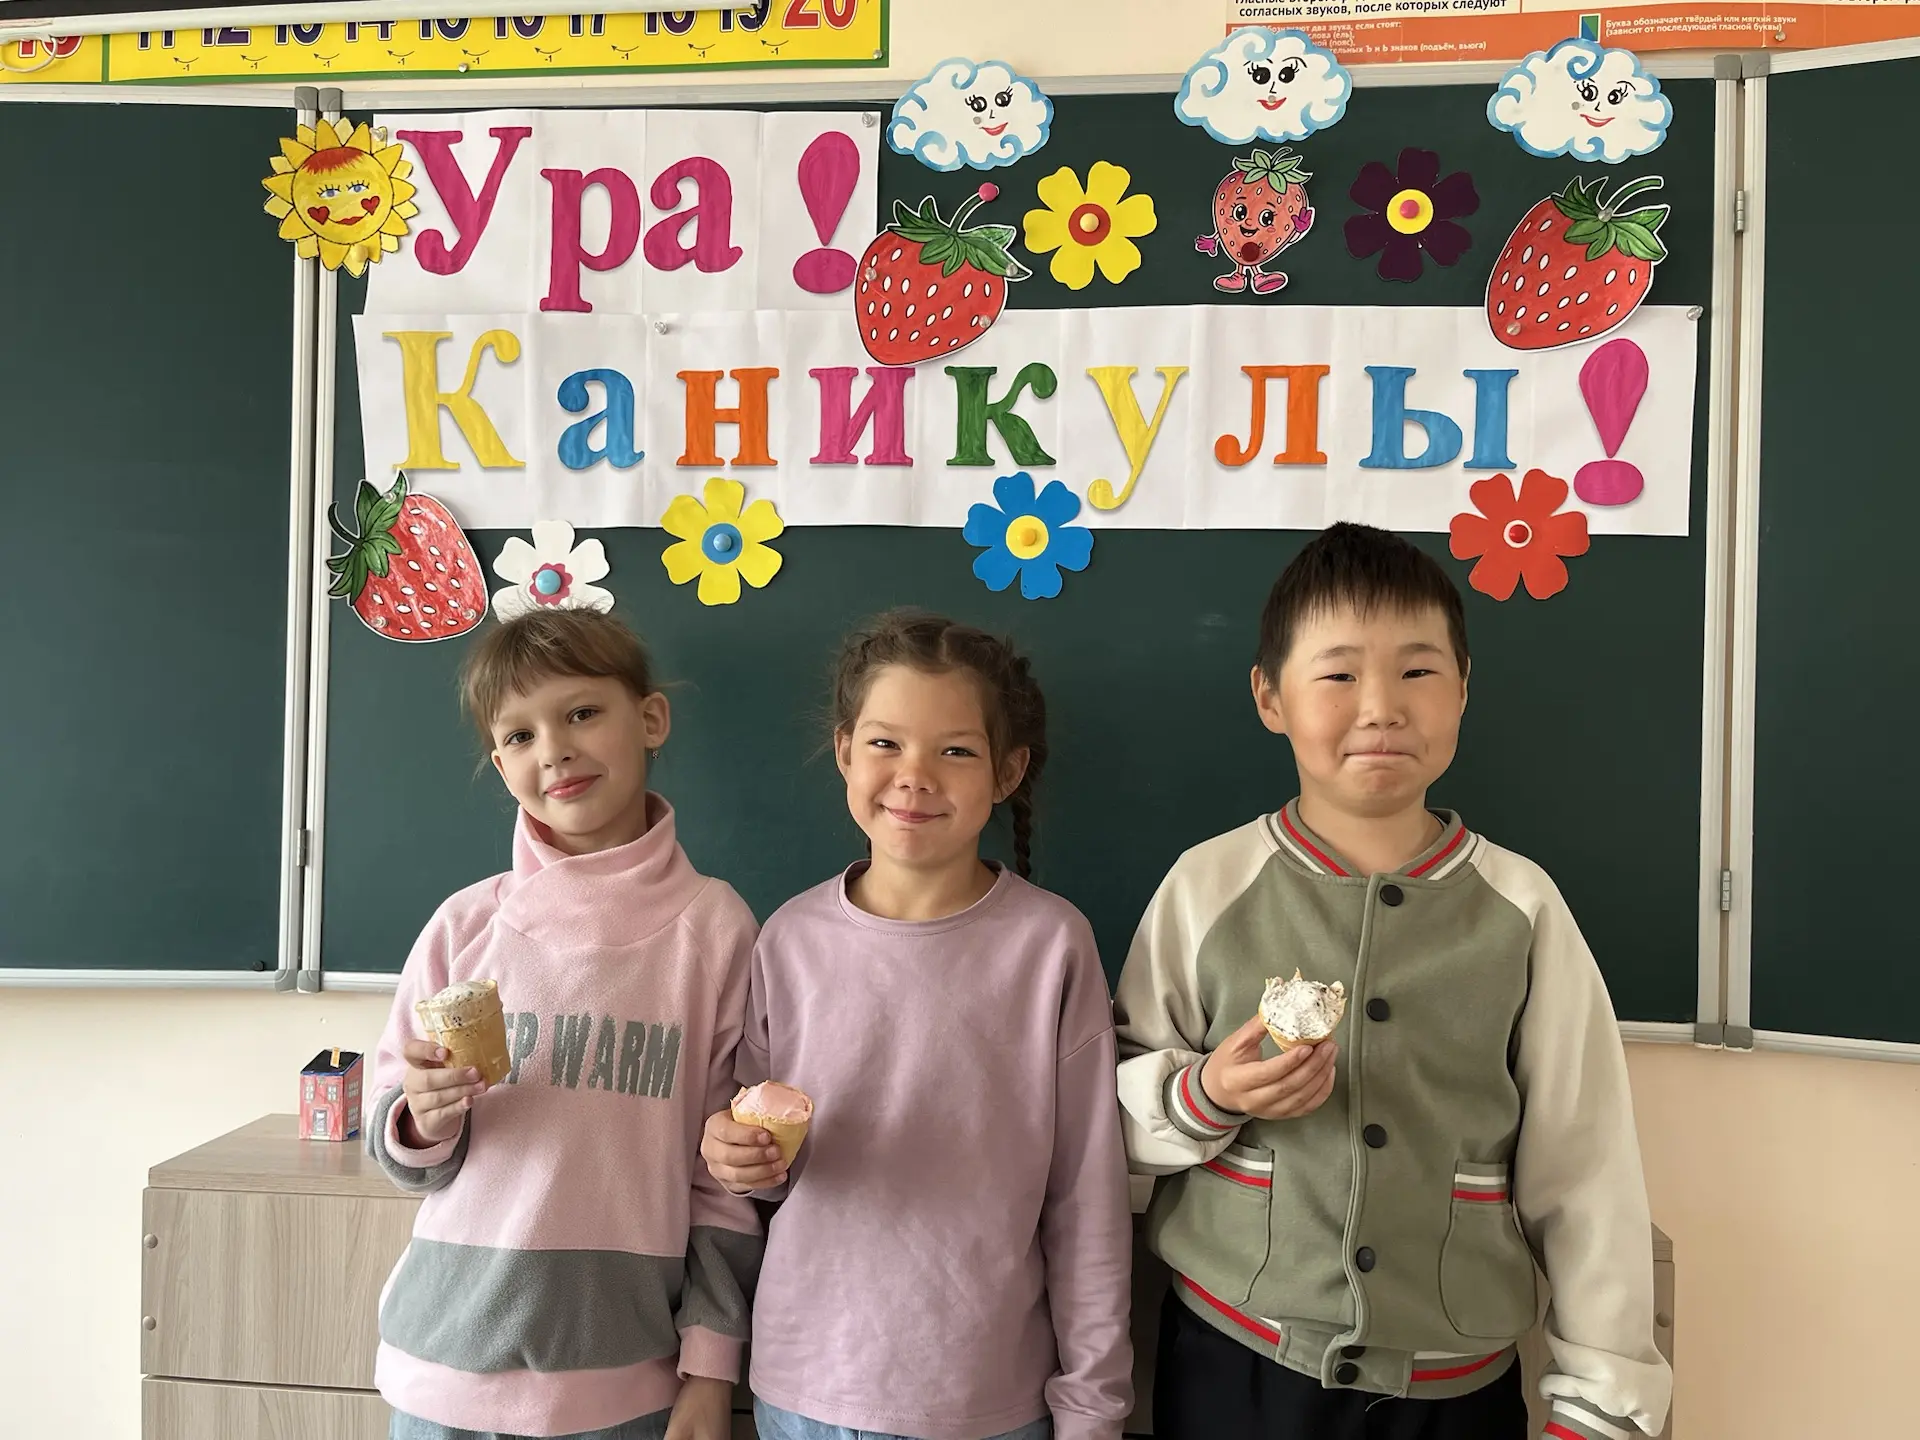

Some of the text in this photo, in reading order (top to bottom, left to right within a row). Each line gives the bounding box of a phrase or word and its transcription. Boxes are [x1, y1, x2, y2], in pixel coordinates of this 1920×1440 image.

[1239, 6, 1303, 17] согласных
[1306, 4, 1351, 16] звуков,
[1355, 2, 1391, 13] после
[1395, 0, 1449, 13] которых
[1453, 0, 1507, 11] следуют
[1605, 19, 1631, 29] Буква
[1633, 17, 1684, 26] обозначает
[1685, 14, 1722, 24] твёрдый
[1741, 15, 1771, 23] мягкий
[1773, 16, 1797, 25] звуки
[1328, 24, 1354, 32] звука,
[1605, 22, 1782, 37] (зависит от последующей гласной буквы)
[1390, 44, 1418, 52] знаков
[1420, 42, 1457, 52] (подъём,
[1458, 41, 1487, 51] вьюга)
[698, 50, 706, 59] -1
[770, 47, 780, 56] -1
[472, 56, 481, 65] -1
[544, 54, 553, 63] -1
[621, 52, 630, 61] -1
[250, 62, 258, 70] -1
[323, 60, 331, 68] -1
[397, 57, 406, 66] -1
[182, 63, 191, 72] -1
[550, 1012, 683, 1099] WARM
